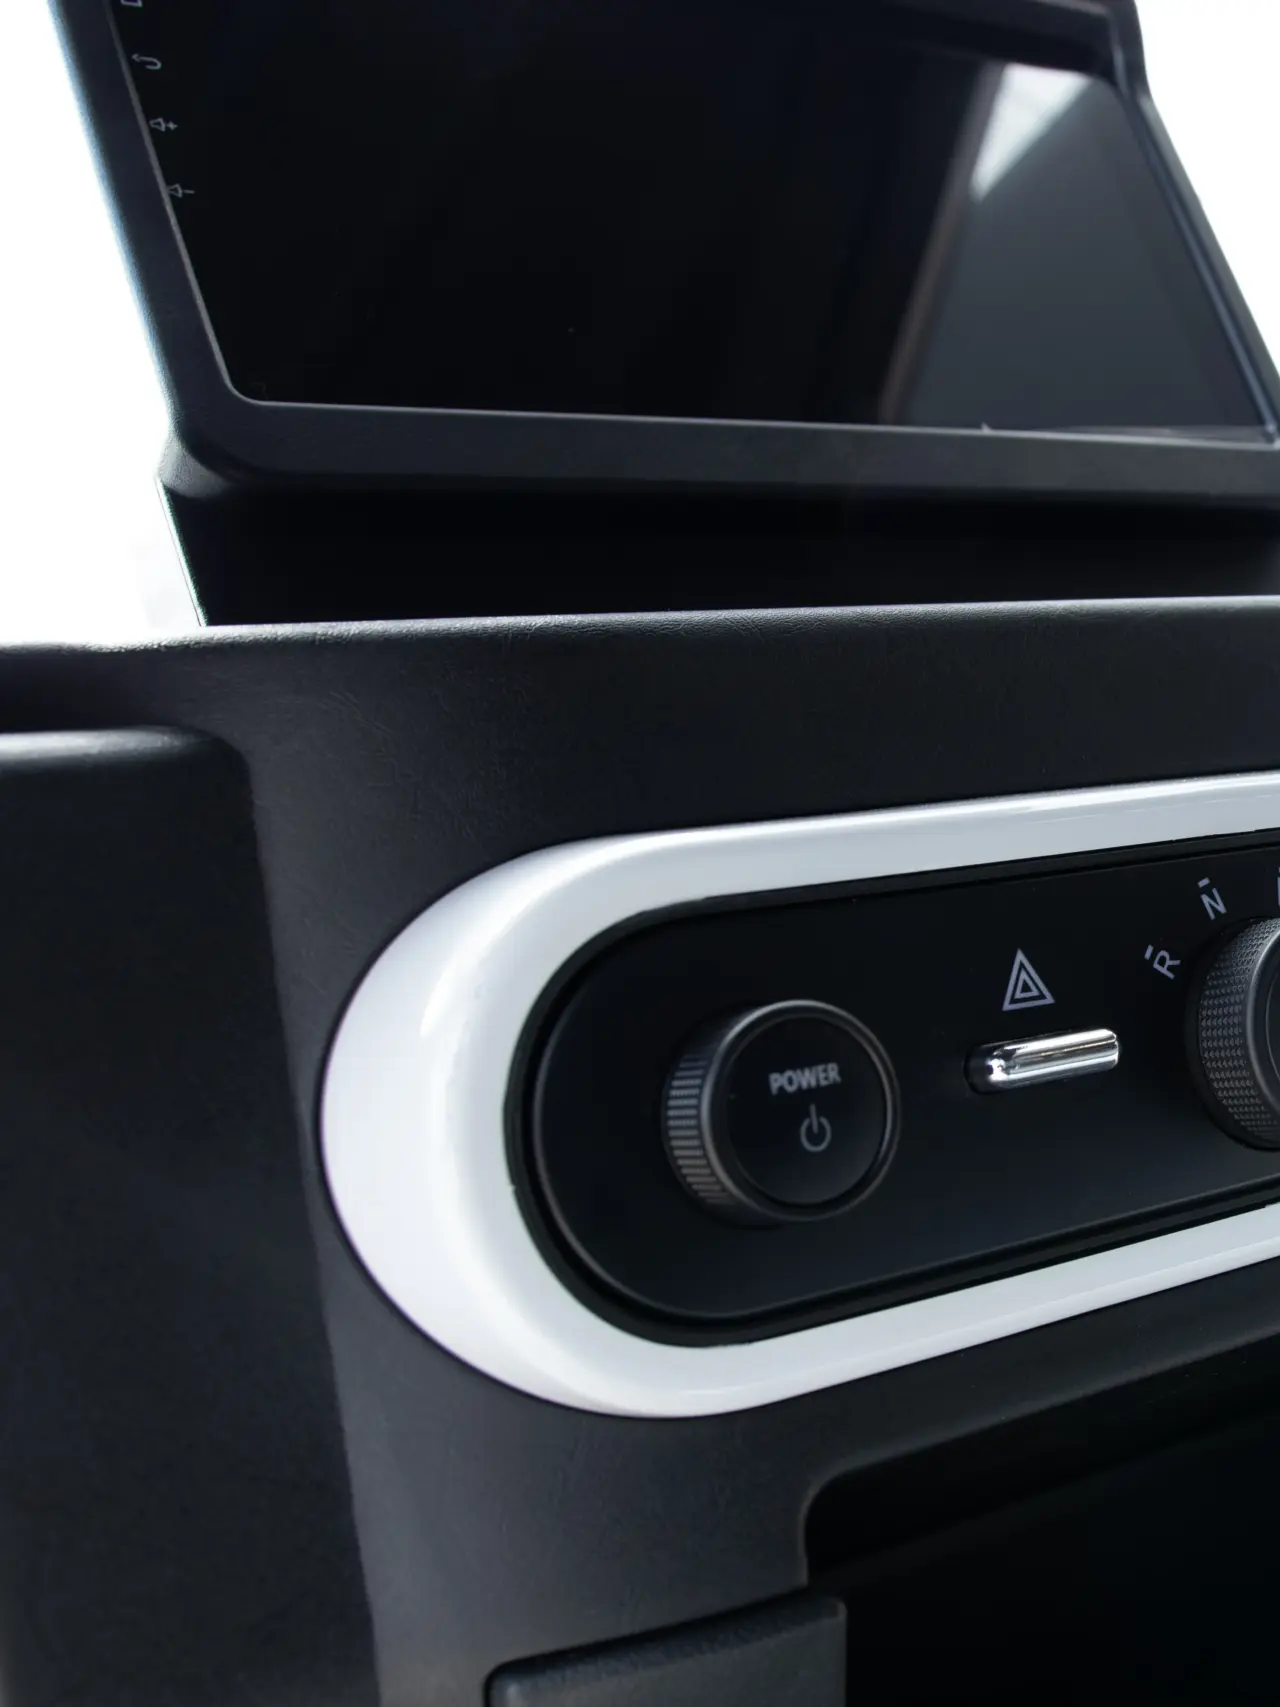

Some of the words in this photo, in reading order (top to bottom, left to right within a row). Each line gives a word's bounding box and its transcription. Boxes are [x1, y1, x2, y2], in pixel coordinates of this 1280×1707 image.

[1200, 888, 1227, 920] N
[1153, 949, 1181, 979] R
[768, 1062, 842, 1096] POWER
